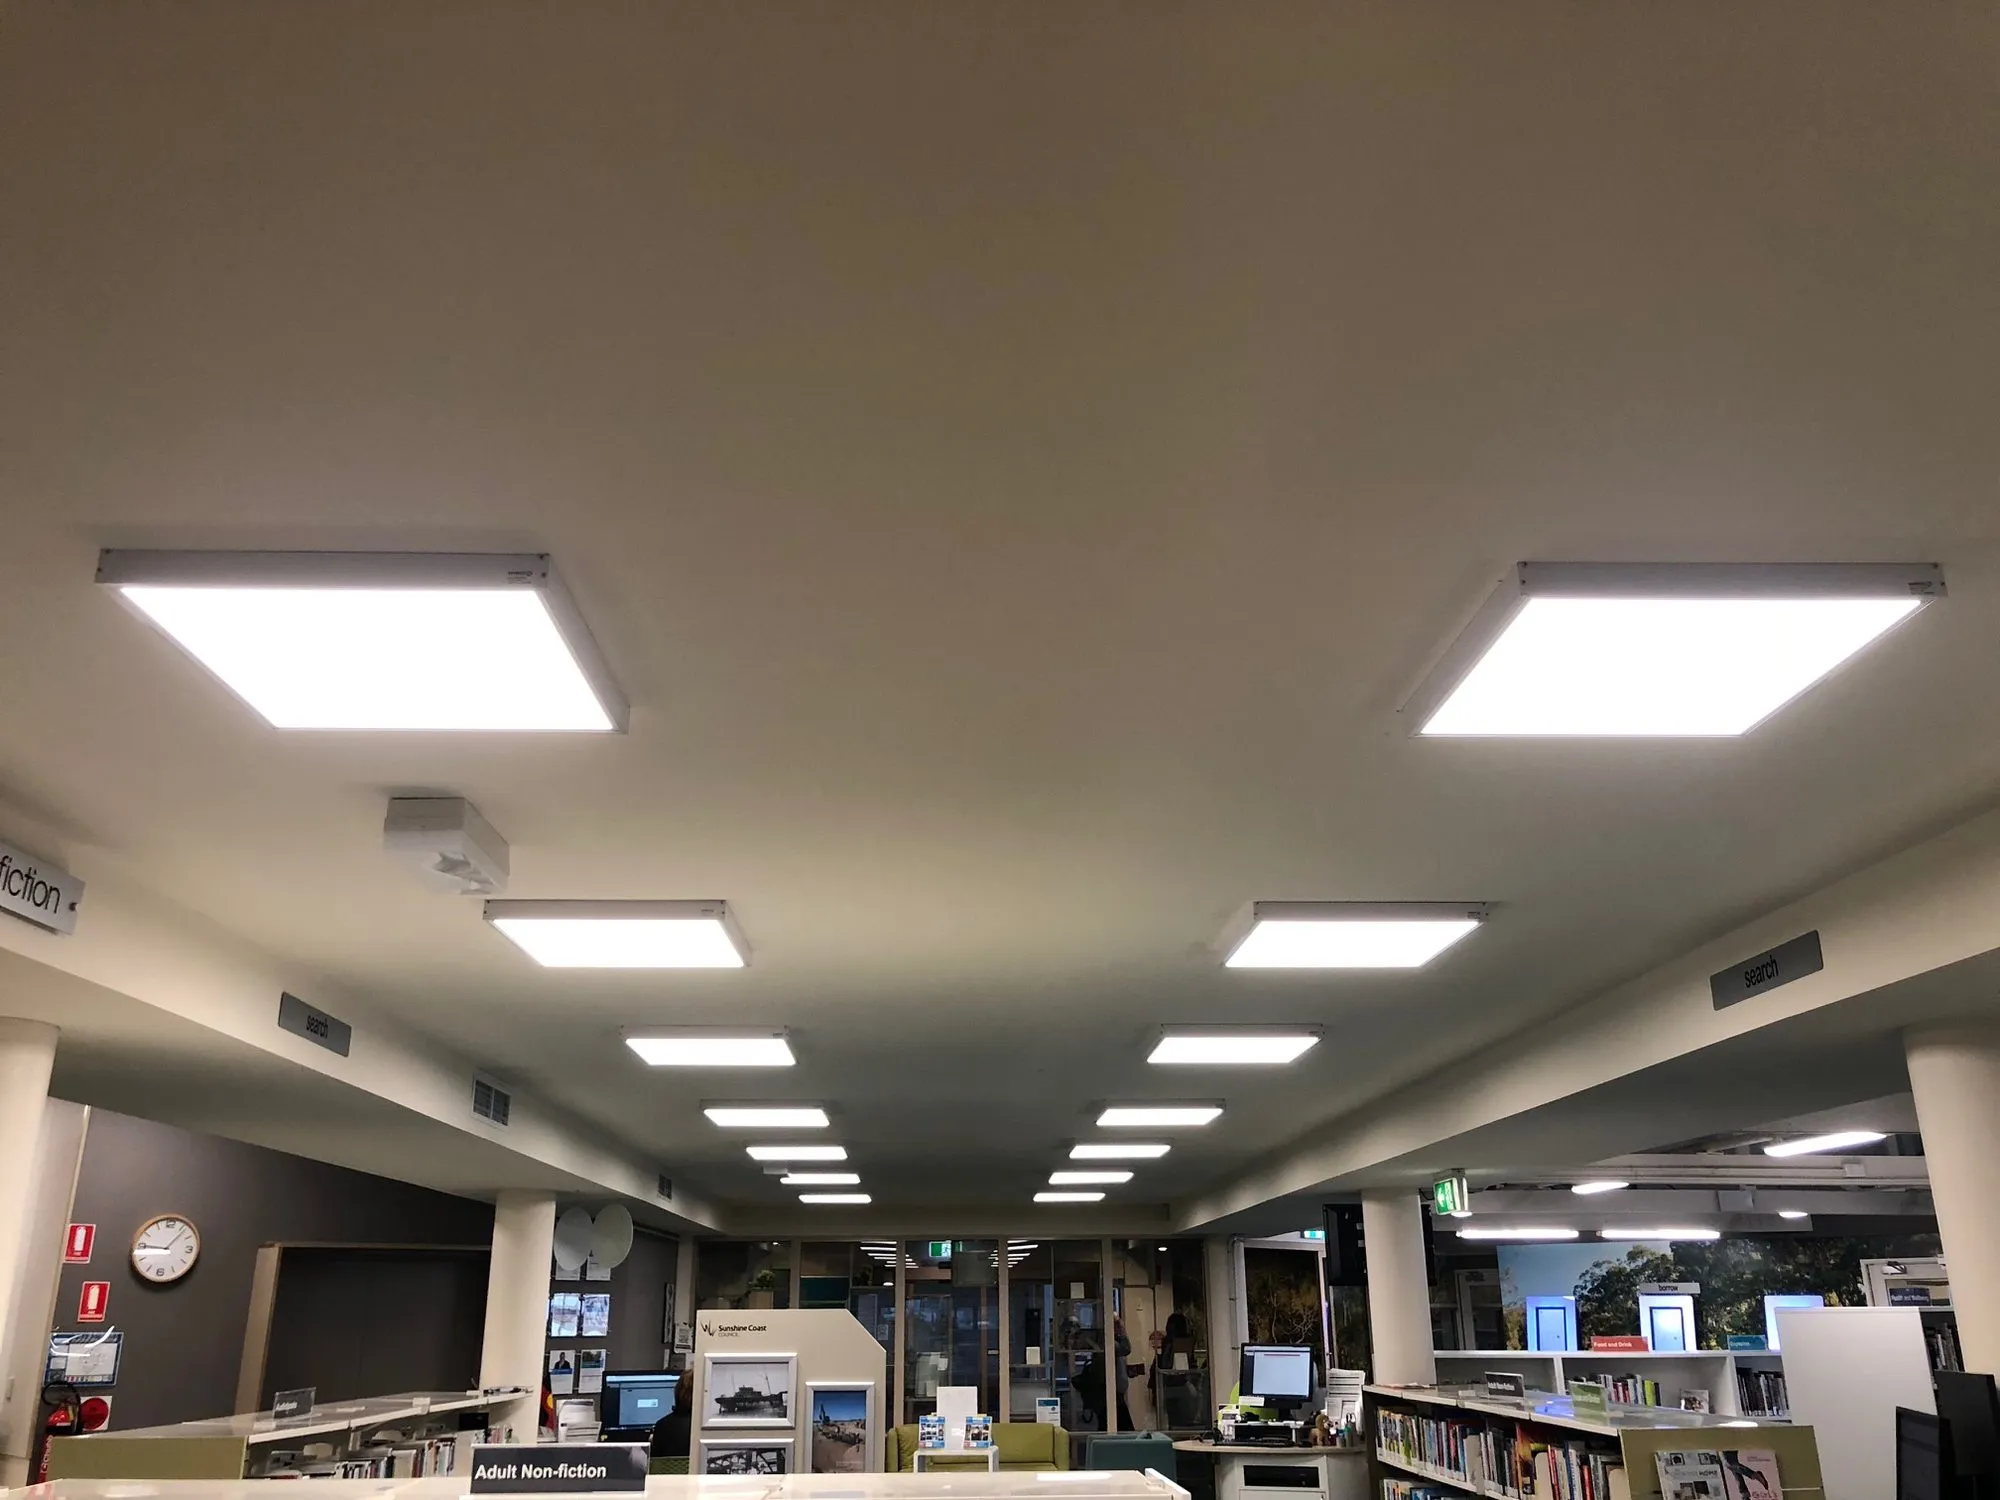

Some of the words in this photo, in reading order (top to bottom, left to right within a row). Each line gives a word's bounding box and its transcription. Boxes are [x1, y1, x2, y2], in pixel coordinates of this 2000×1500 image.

[0, 855, 60, 914] fiction
[1744, 954, 1779, 988] search
[306, 1015, 329, 1039] search
[185, 1245, 194, 1254] 3
[156, 1267, 165, 1277] 6
[1658, 1284, 1679, 1292] borrow
[474, 1464, 516, 1480] Adult
[521, 1463, 607, 1479] Non-fiction
